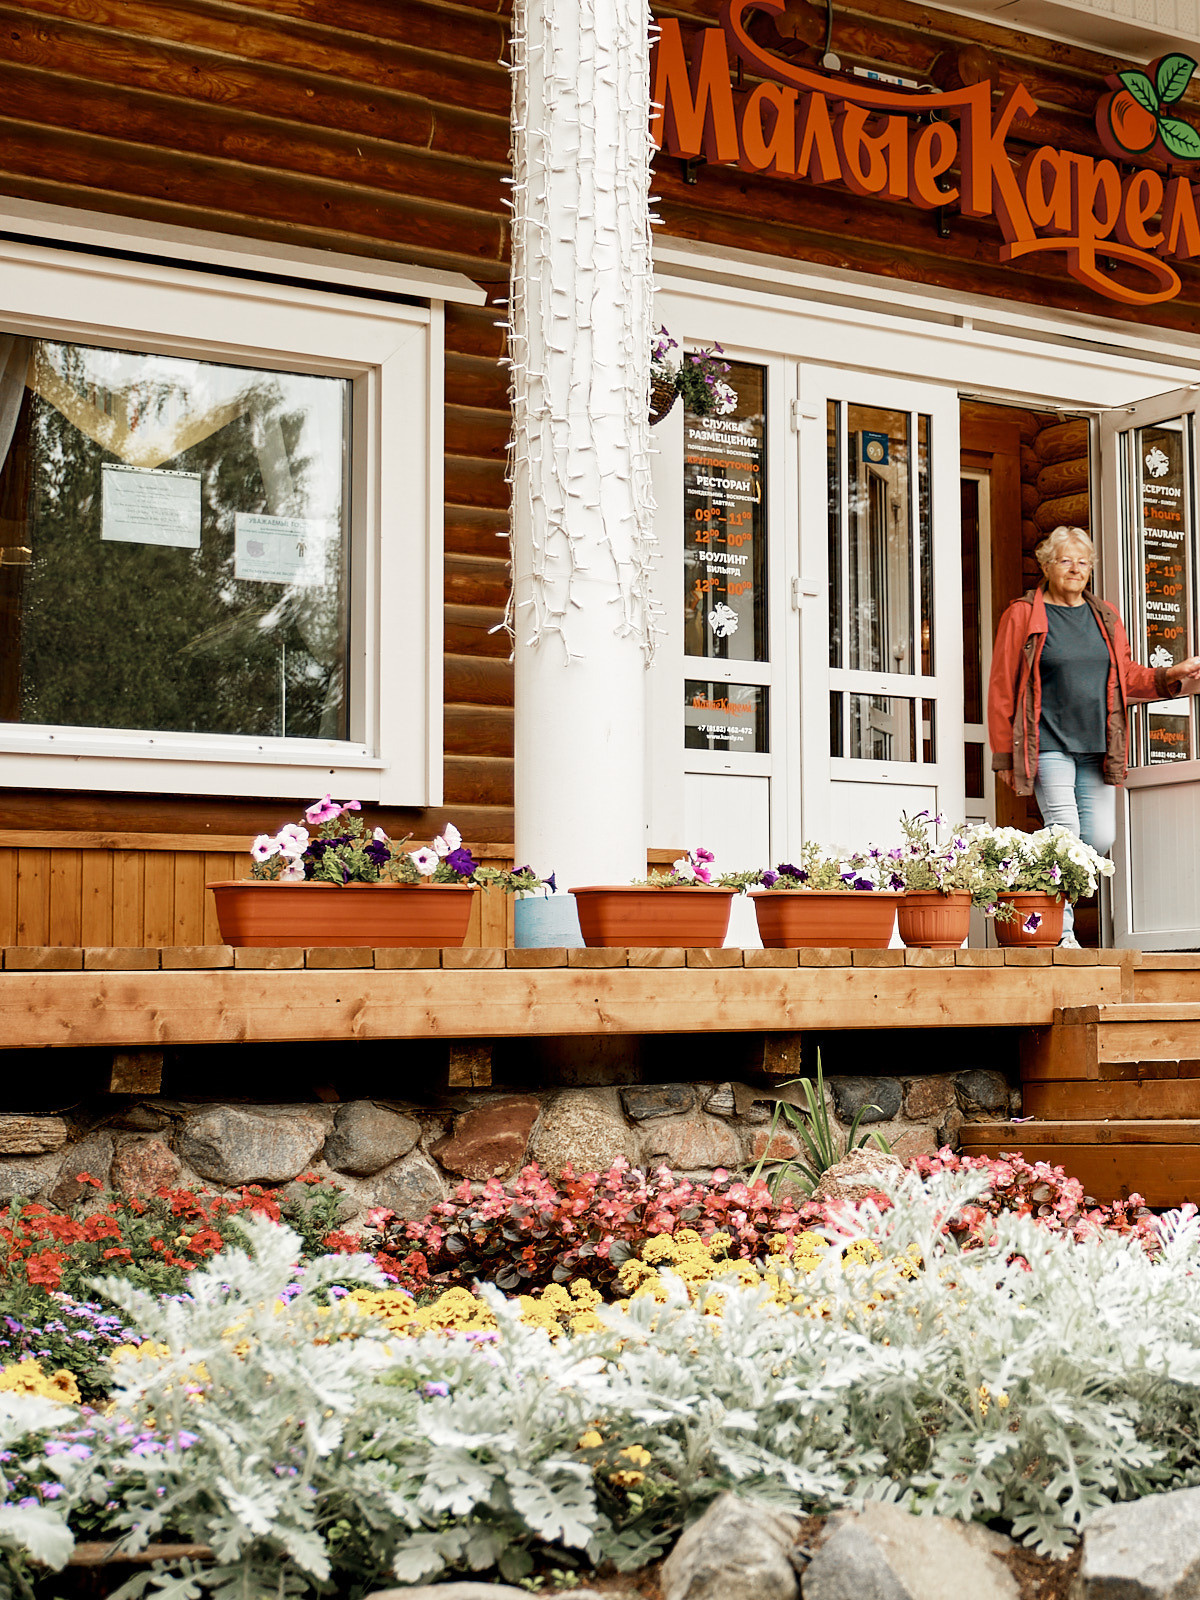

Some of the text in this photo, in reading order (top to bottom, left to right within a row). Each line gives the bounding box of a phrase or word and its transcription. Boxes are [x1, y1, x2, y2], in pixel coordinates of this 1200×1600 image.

[652, 16, 960, 210] Малые
[702, 417, 745, 434] СЛУЖБА
[688, 429, 758, 448] РАЗМЕЩЕНИЯ
[687, 456, 760, 473] КРУГЛОСУТОЧНО
[696, 475, 751, 492] РЕСТОРАН
[1143, 483, 1181, 498] ECEPTION
[712, 499, 735, 508] ЗАВТРАК
[1151, 507, 1181, 522] hours
[1144, 527, 1185, 541] STAURANT
[699, 550, 749, 566] БОУЛИНГ
[706, 564, 741, 577] БИЛЬЯРД
[1146, 601, 1181, 613] OWLING
[697, 724, 706, 732] +7
